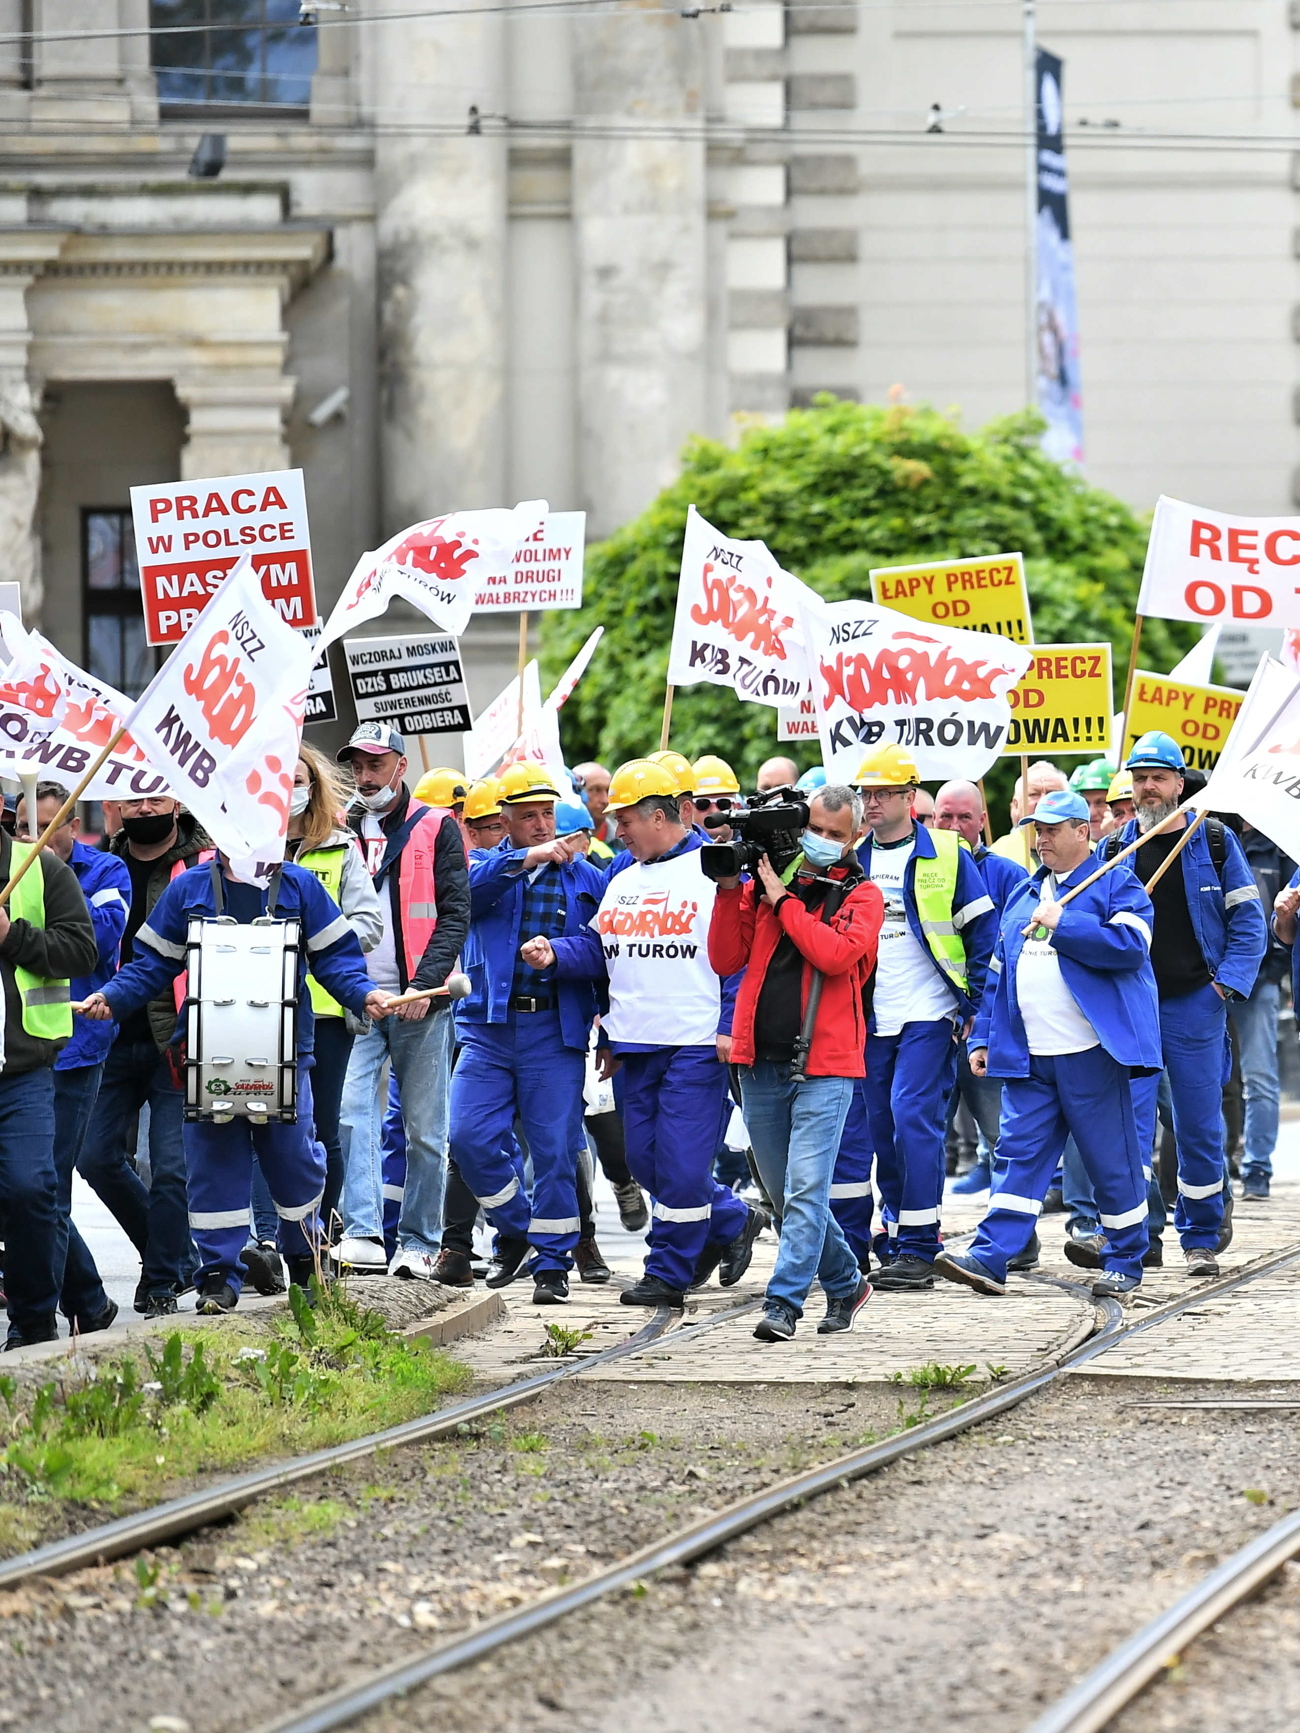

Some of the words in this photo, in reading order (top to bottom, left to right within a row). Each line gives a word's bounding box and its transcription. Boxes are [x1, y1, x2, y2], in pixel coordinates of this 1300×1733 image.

[149, 485, 289, 524] PRACA
[147, 534, 173, 555] W
[183, 521, 295, 551] POLSCE
[706, 545, 744, 573] NSZZ
[155, 561, 299, 600] NASYM
[514, 568, 561, 584] DRUGI
[880, 575, 935, 601] ŁAPY
[946, 566, 1016, 593] PRECZ
[931, 599, 971, 620] OD
[1184, 579, 1273, 619] OD
[227, 609, 266, 663] NSZZ
[829, 619, 880, 646] NSZZ
[349, 648, 403, 667] WCZORAJ
[406, 639, 456, 658] MOSKWA
[356, 671, 387, 695] DZIŚ
[389, 664, 460, 690] BRUKSELA
[373, 688, 453, 714] SUWERENNOŚĆ
[1006, 688, 1045, 709] OD
[1138, 683, 1195, 711] ŁAPY
[404, 709, 464, 732] ODBIERA
[1181, 719, 1221, 741] OD
[155, 703, 217, 789] KWB
[870, 873, 900, 882] SPIERAM
[626, 940, 698, 959] TURÓW
